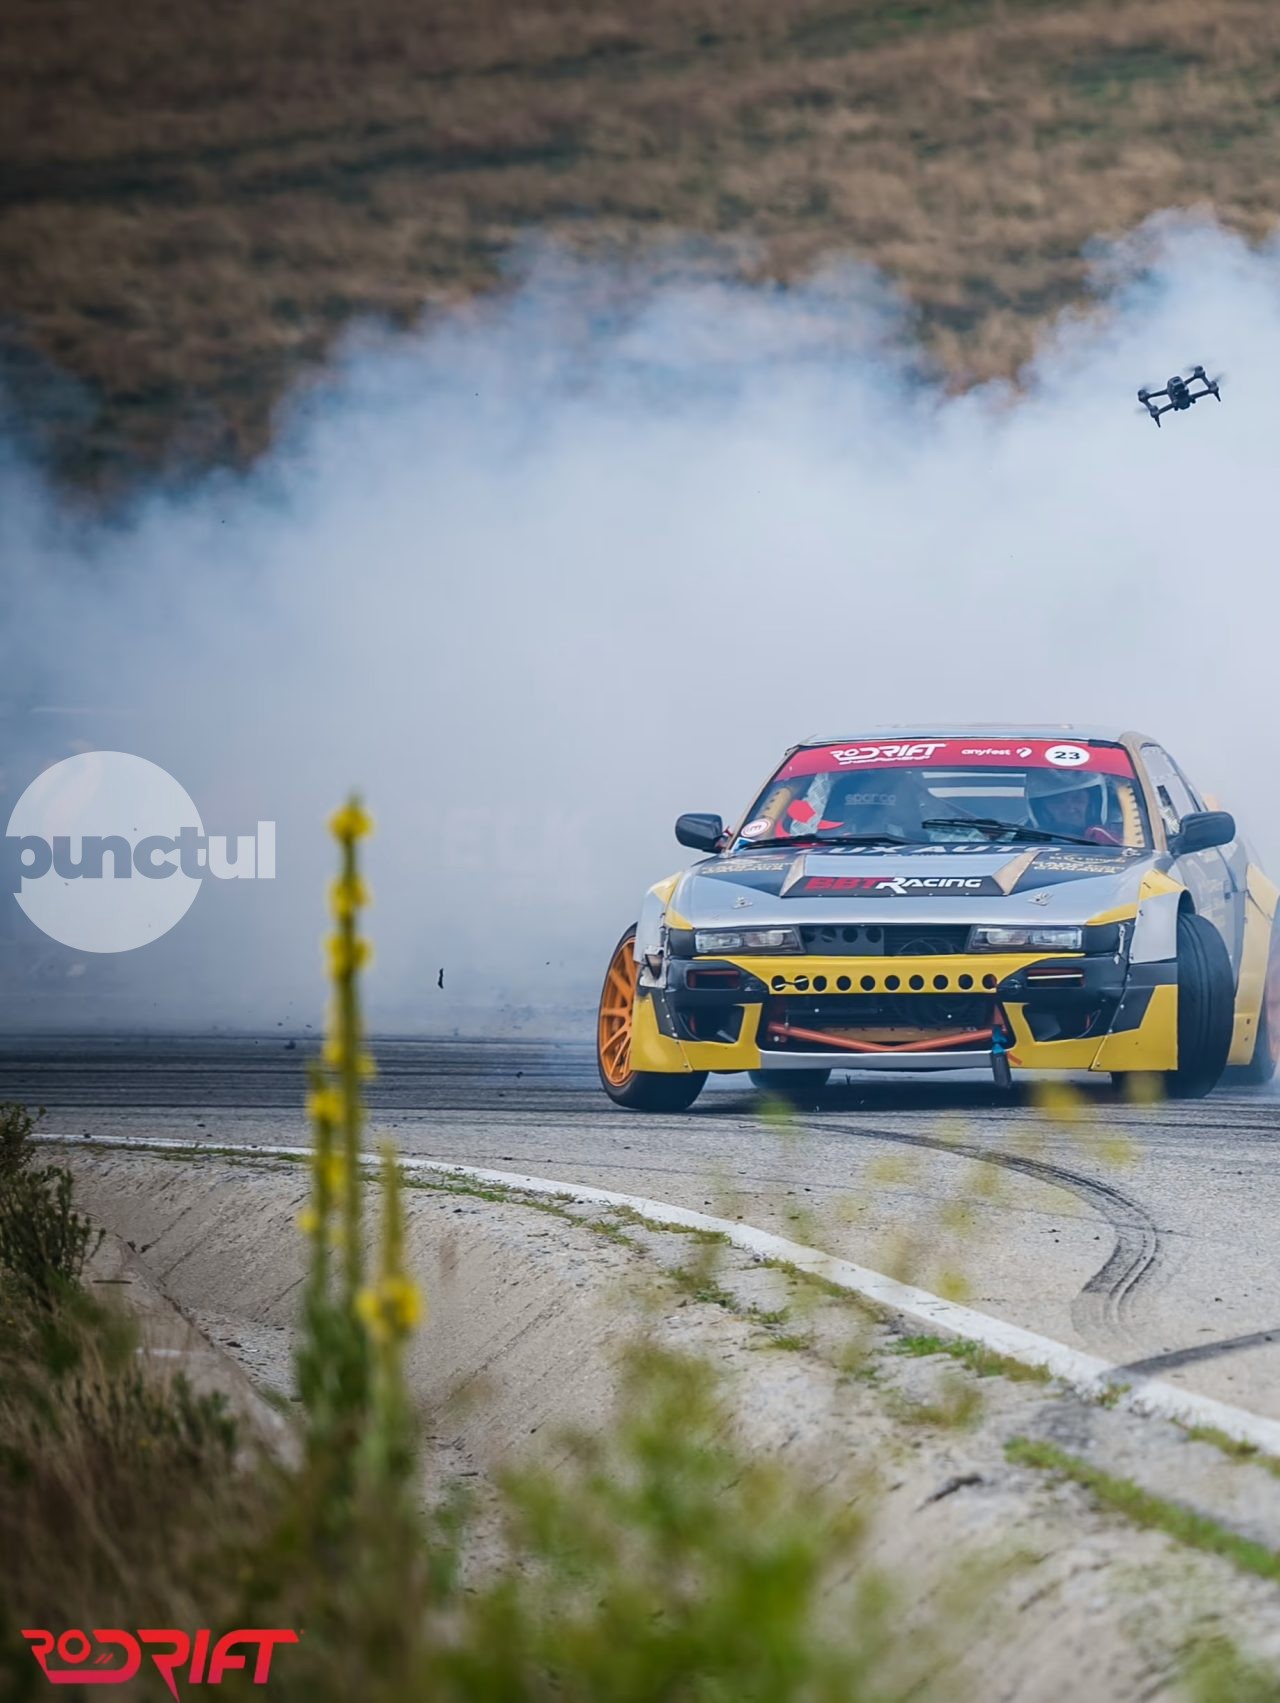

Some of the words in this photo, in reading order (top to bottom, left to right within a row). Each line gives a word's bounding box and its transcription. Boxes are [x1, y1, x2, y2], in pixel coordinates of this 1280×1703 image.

[829, 743, 947, 762] RODRIFT
[960, 747, 1010, 757] anyfest
[1053, 750, 1080, 760] 23
